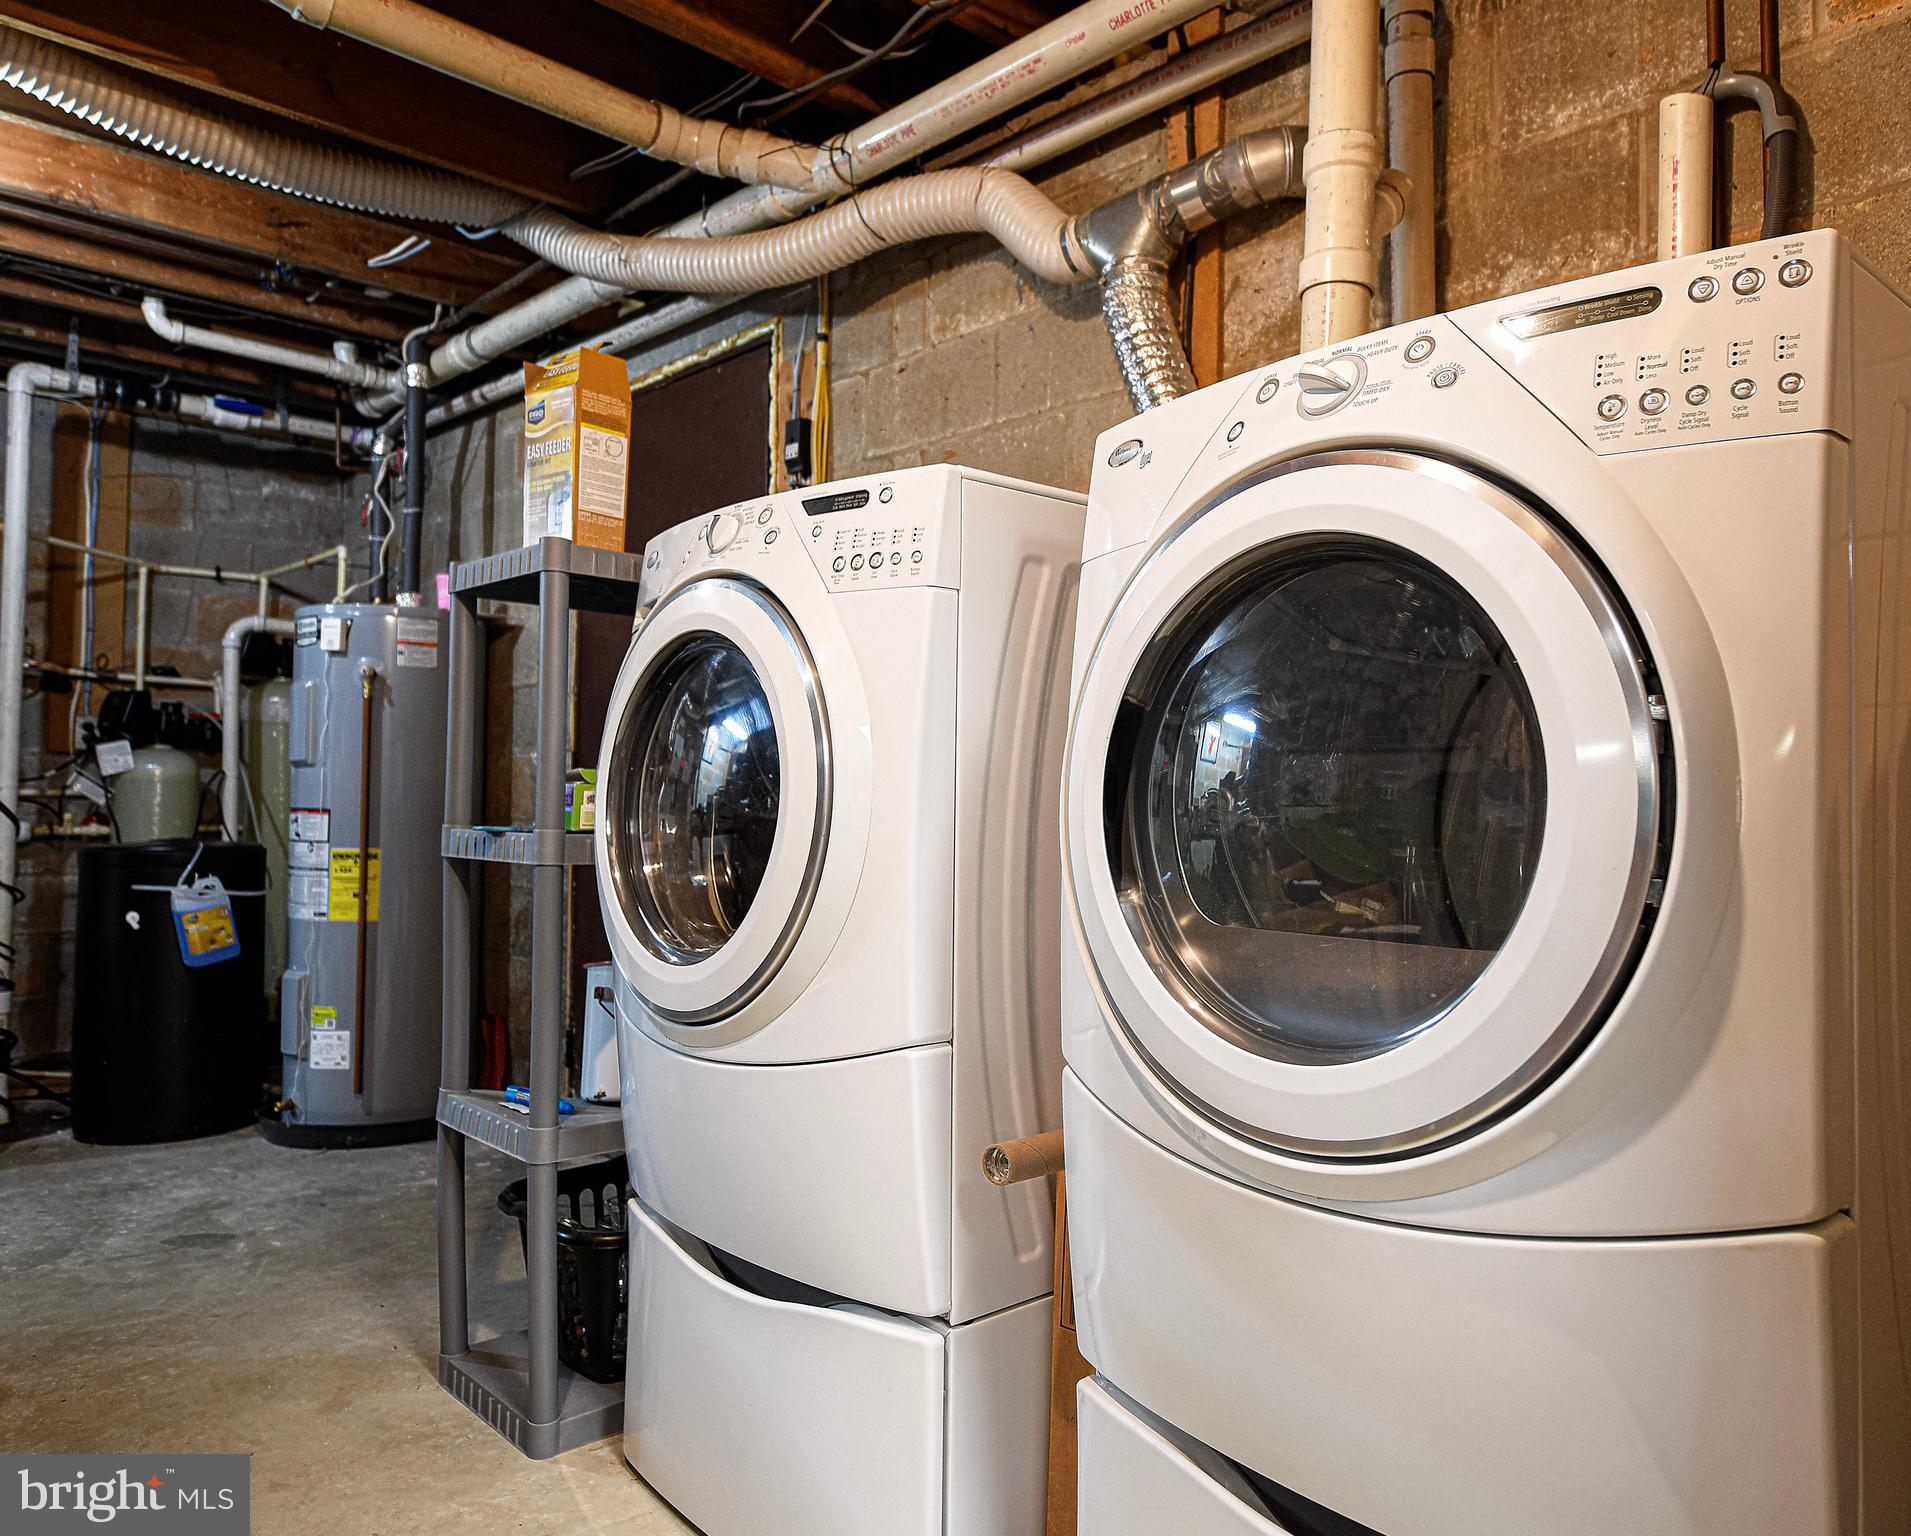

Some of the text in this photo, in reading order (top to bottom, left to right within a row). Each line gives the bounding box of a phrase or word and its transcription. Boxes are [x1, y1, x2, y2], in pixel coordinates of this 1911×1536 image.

[1108, 0, 1157, 31] CHARLOTTE
[900, 124, 916, 139] PIPE
[1783, 241, 1805, 249] Wrinkle
[1785, 248, 1803, 256] Shield
[1706, 252, 1746, 266] Adjust Manual
[1632, 292, 1654, 301] Sensing
[1735, 296, 1761, 305] OPTIONS
[1606, 310, 1619, 318] Cool
[1415, 329, 1432, 337] START
[1785, 333, 1801, 341] Loud
[1356, 340, 1389, 352] BULKY ITEMS
[1785, 342, 1798, 350] Soft
[1331, 346, 1353, 356] NORMAL
[1366, 345, 1399, 357] HEAVY DUTY
[1449, 362, 1466, 375] CANCEL
[1646, 361, 1668, 370] Normal
[1361, 385, 1391, 396] TIMED DRY
[1352, 399, 1370, 408] TOUCH
[1733, 404, 1748, 412] Cycle
[1779, 406, 1799, 414] Sound
[1681, 411, 1697, 419] Damp
[1731, 411, 1750, 420] Signal
[1640, 417, 1662, 425] Dryness
[1679, 416, 1710, 426] Cycle Signal
[1593, 422, 1625, 431] Temperature
[527, 437, 571, 460] EASY FEEDER
